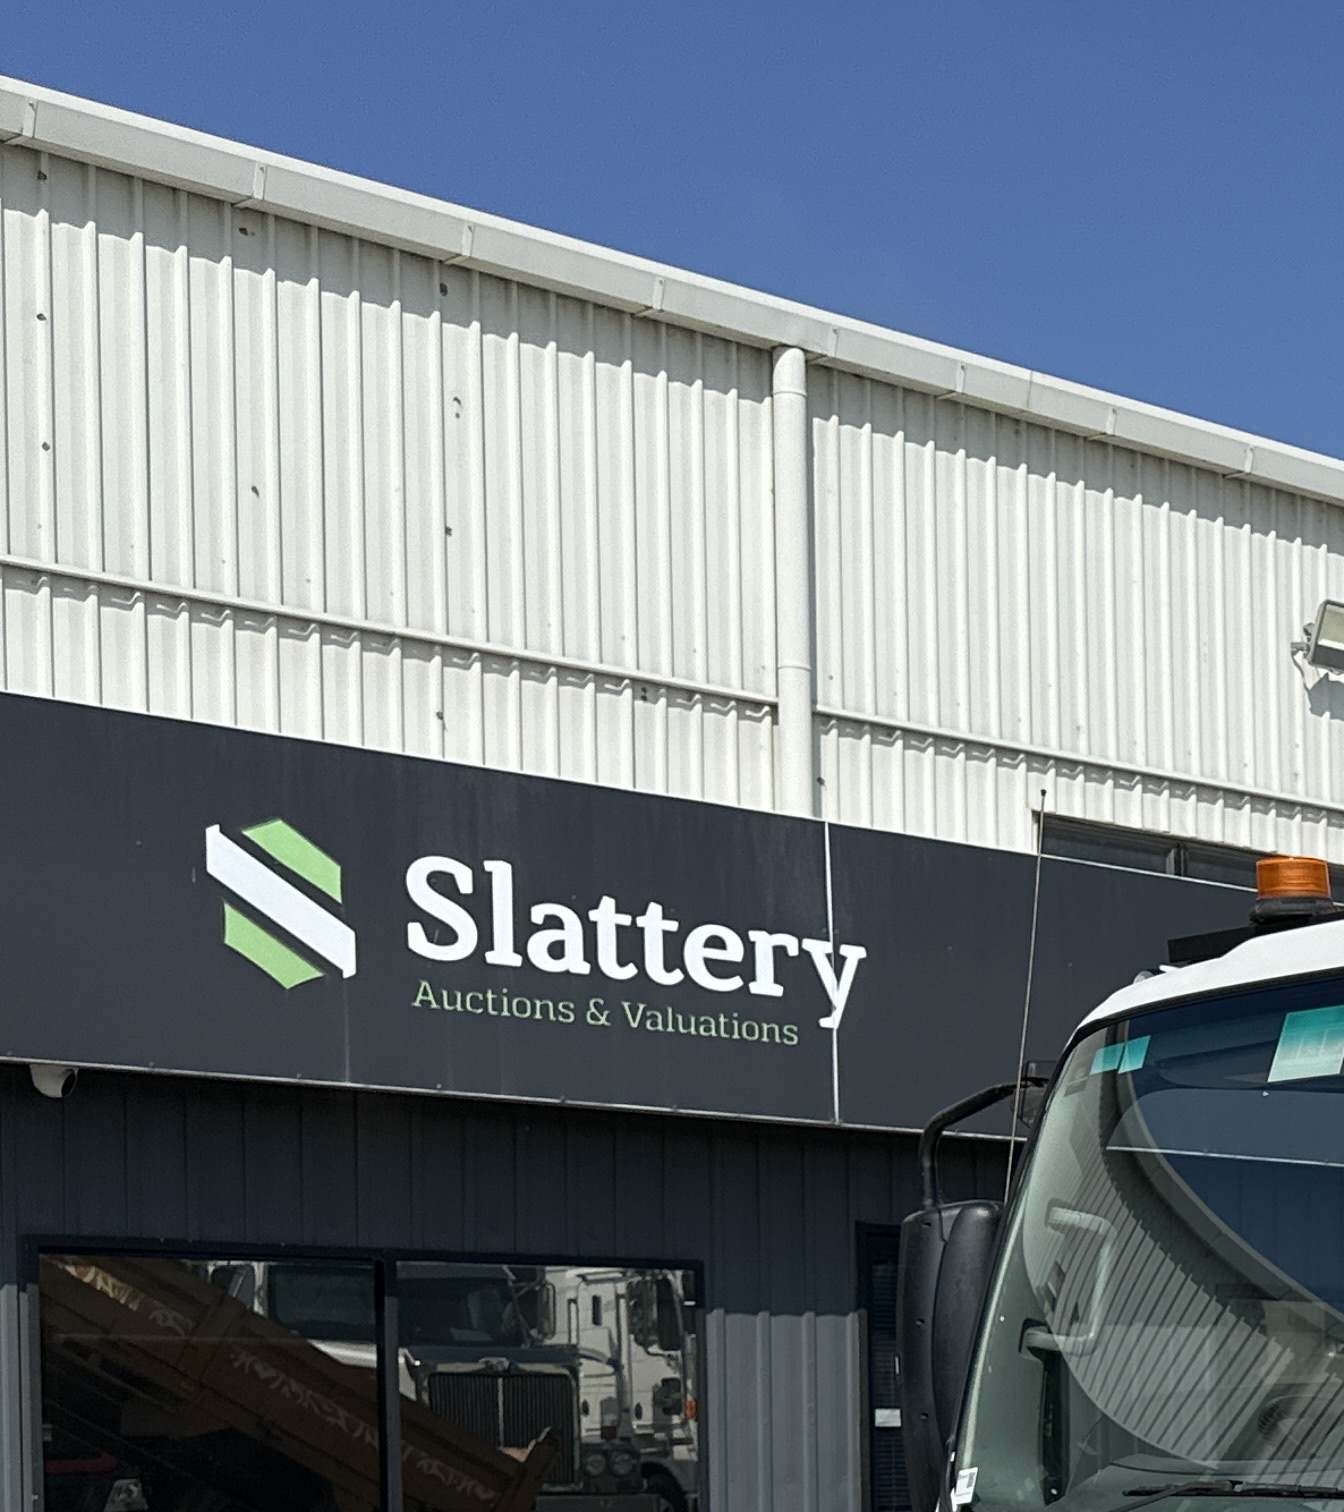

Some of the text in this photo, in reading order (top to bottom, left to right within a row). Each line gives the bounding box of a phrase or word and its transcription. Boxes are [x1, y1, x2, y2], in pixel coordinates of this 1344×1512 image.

[405, 855, 867, 1030] Slattery
[411, 980, 800, 1046] Auctions & Valuations
